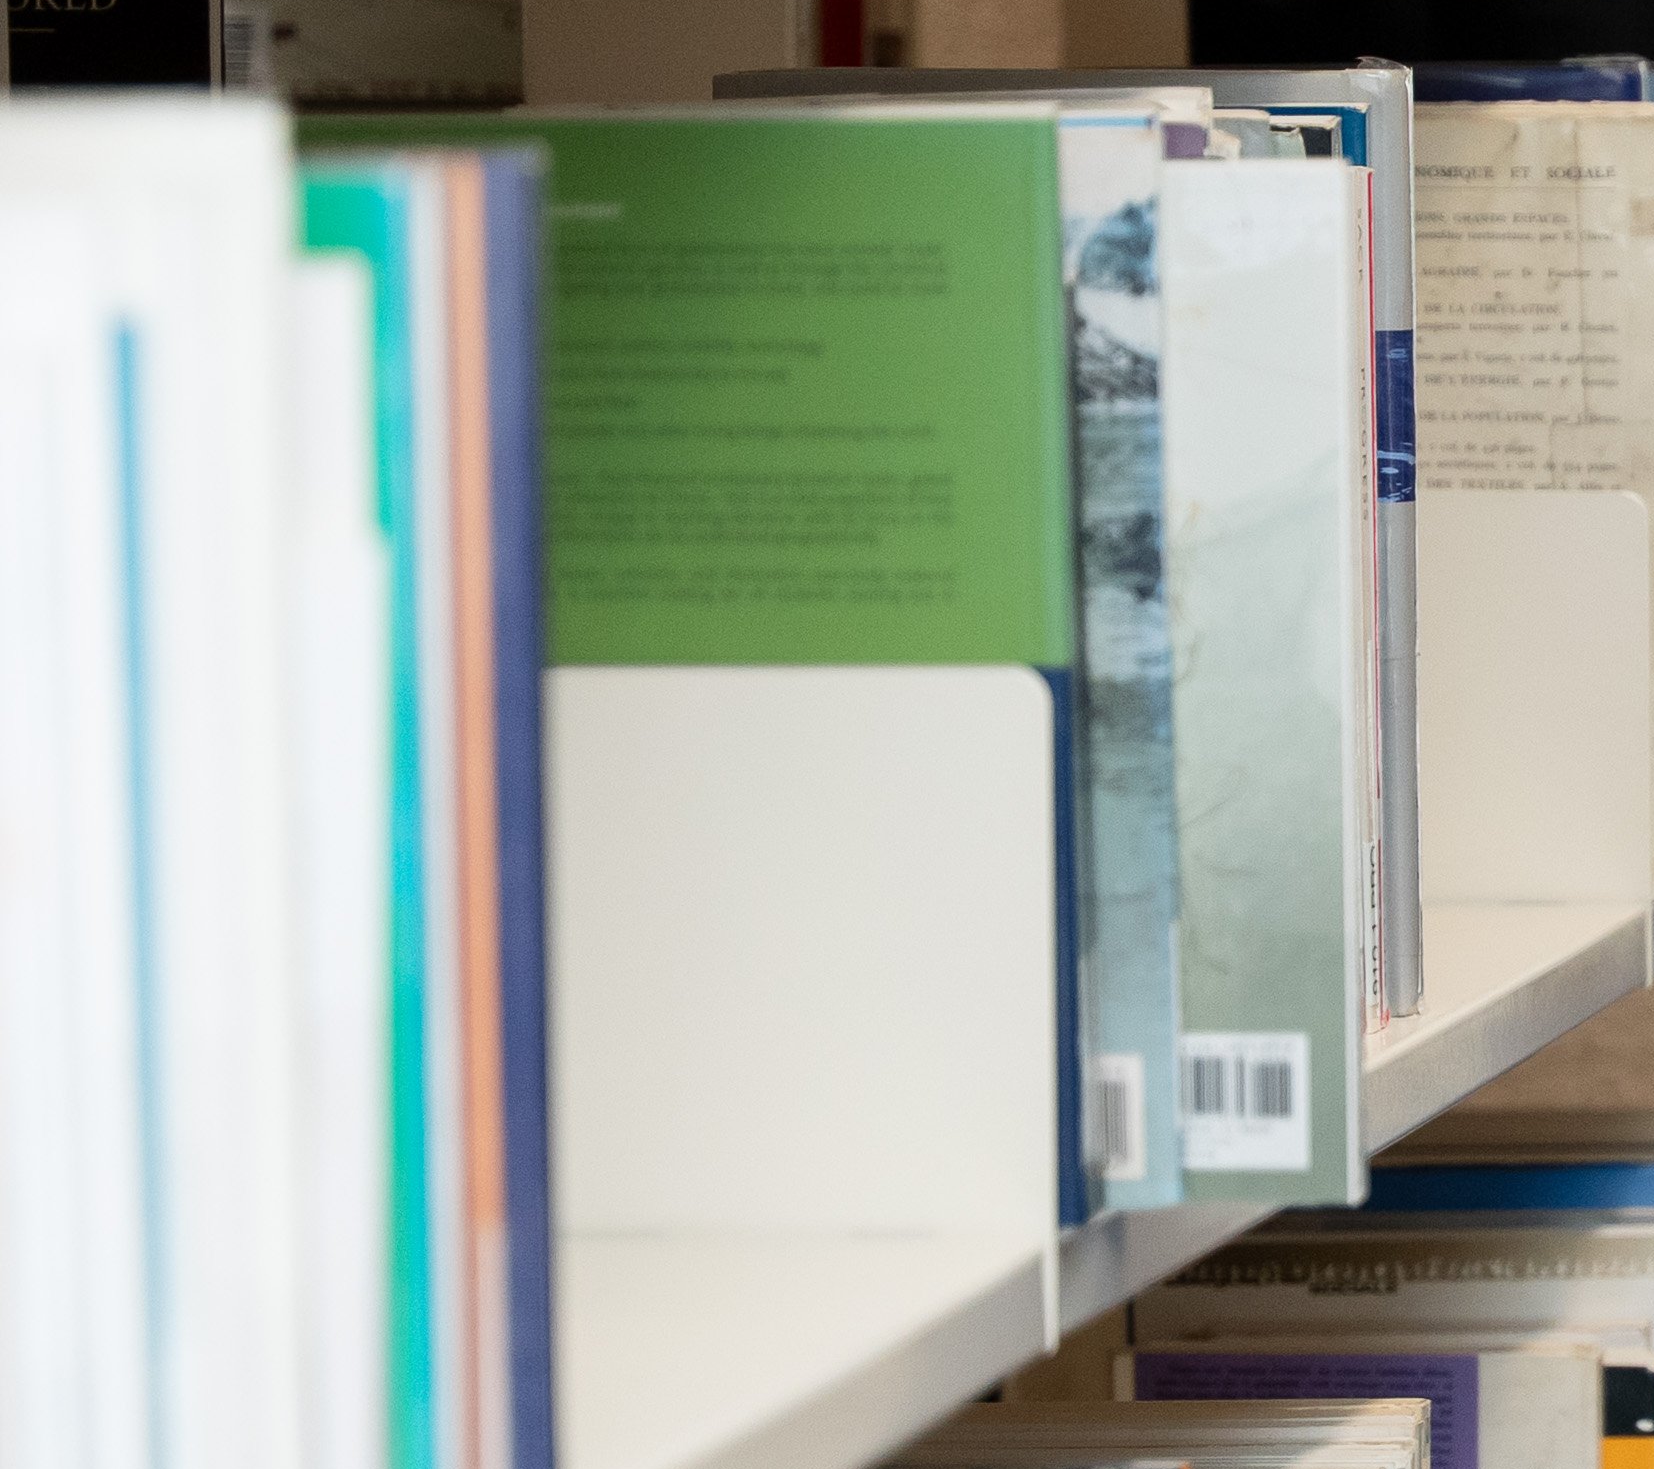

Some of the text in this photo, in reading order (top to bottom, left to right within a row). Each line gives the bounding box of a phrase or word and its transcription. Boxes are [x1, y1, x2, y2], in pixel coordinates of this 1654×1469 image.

[1511, 166, 1531, 180] ET
[1546, 165, 1616, 180] SOCIALE
[1359, 367, 1368, 521] PROGRESS
